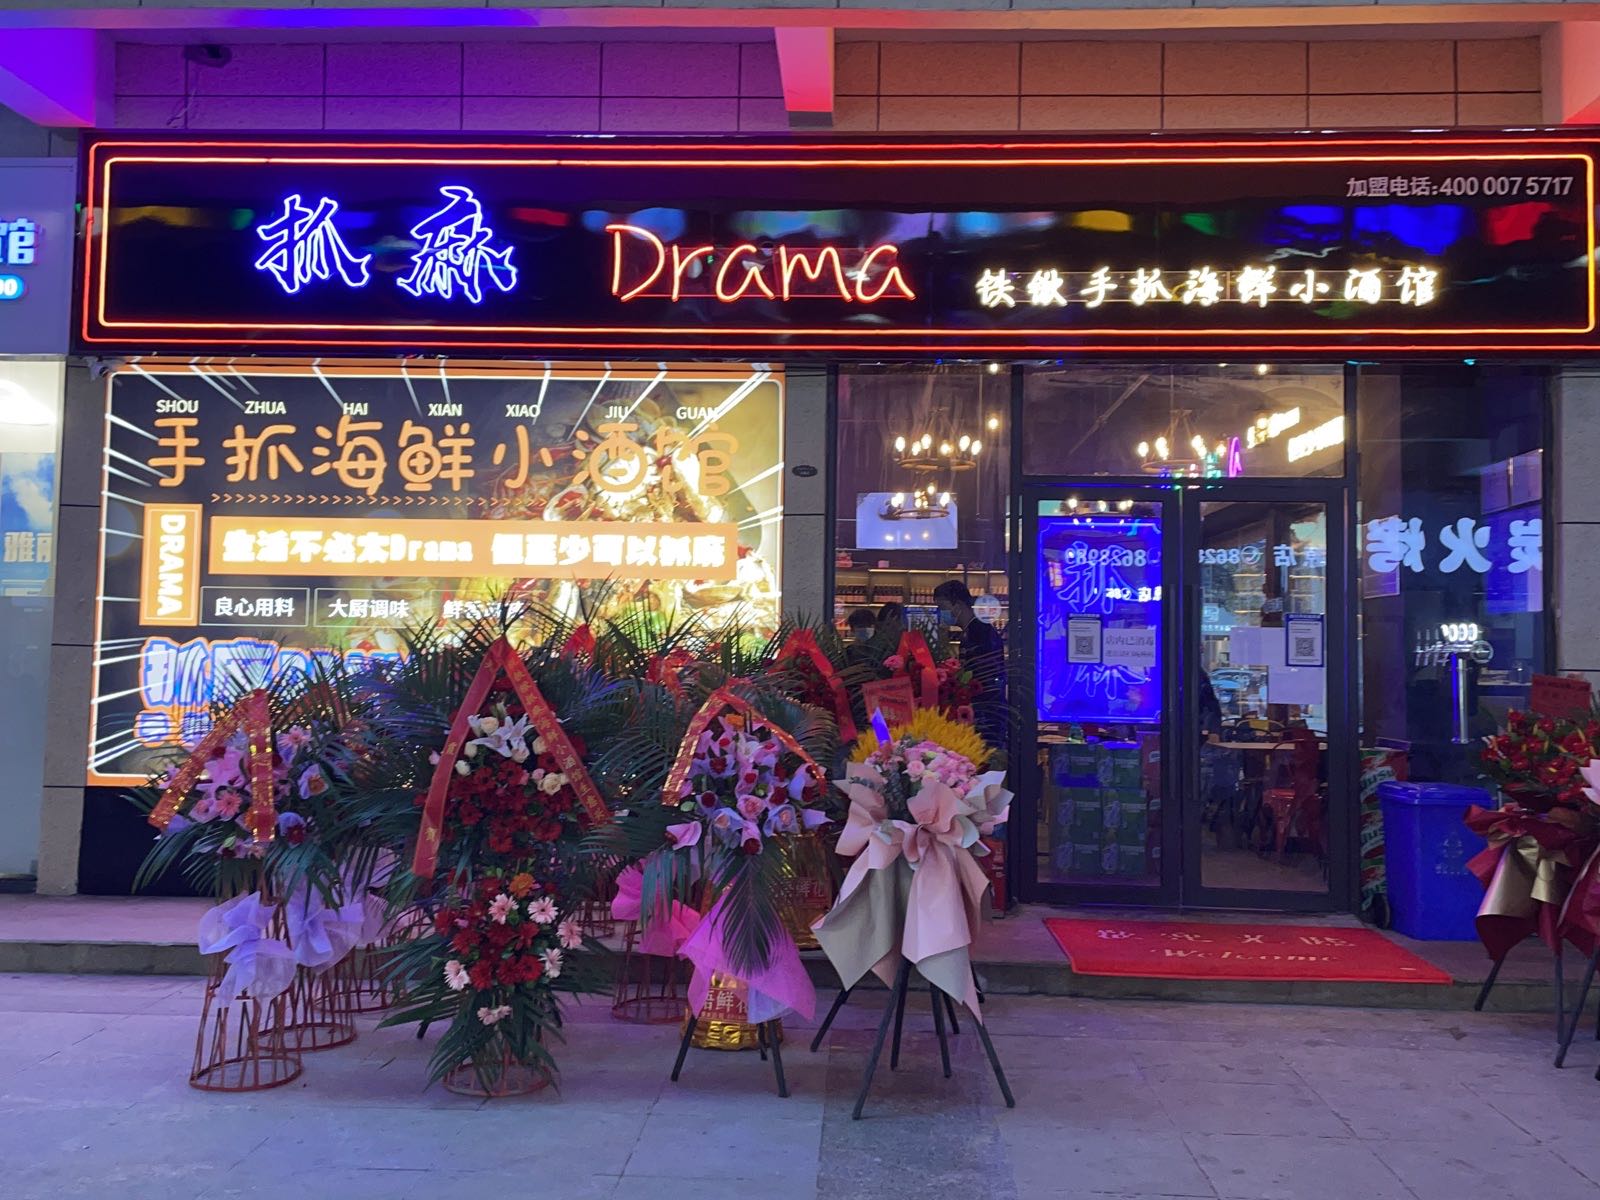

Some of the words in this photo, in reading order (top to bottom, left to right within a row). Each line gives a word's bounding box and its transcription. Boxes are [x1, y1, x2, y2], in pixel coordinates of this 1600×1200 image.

[1483, 176, 1522, 196] 007
[1525, 176, 1574, 196] 5717
[605, 223, 916, 302] Drama
[156, 400, 199, 414] SHOU
[244, 401, 287, 415] ZHUA
[343, 403, 368, 416] HAI
[428, 403, 462, 417] XIAN
[505, 404, 541, 418] XIAO
[605, 406, 628, 420] JIU
[676, 406, 717, 420] GUAN
[148, 415, 738, 497] 手抓海鲜小酒馆
[156, 514, 186, 617] DRAMA
[214, 597, 295, 618] 良心用料
[327, 600, 409, 618] 大厨调味
